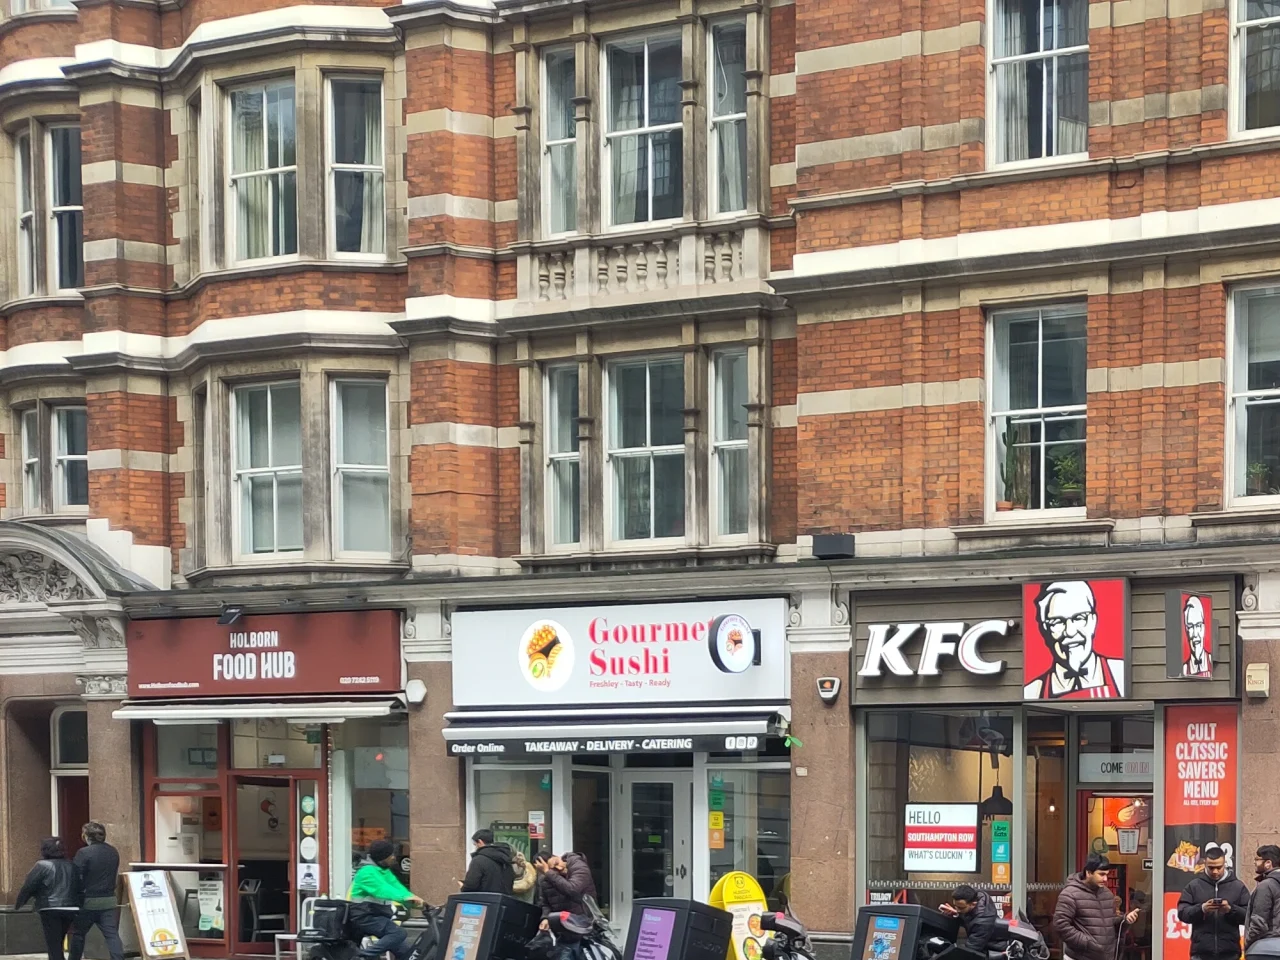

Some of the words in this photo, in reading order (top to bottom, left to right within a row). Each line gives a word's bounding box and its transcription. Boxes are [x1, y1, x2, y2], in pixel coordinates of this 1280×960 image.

[230, 630, 278, 648] HOLBORN
[857, 619, 1009, 676] KFC
[213, 652, 257, 680] FOOD
[260, 651, 295, 679] HUB
[588, 647, 671, 676] Sushi
[589, 680, 619, 689] Freshley
[624, 680, 643, 689] Tasty
[648, 679, 671, 688] Ready
[1187, 723, 1217, 740] CULT
[451, 743, 476, 753] Order
[477, 743, 505, 752] Online
[524, 741, 578, 751] TAKEAWAY
[586, 740, 635, 750] DELIVERY
[641, 738, 692, 749] CATERING
[1175, 742, 1228, 760] CLASSIC
[1100, 762, 1123, 774] COME
[1125, 762, 1138, 774] ON
[1140, 762, 1150, 774] IN
[1177, 761, 1226, 779] SAVERS
[1183, 781, 1219, 798] MENU
[908, 811, 941, 824] HELLO
[907, 833, 957, 842] SOUTHAMPTON
[958, 833, 974, 842] ROW
[908, 850, 934, 859] WHAT'S
[872, 932, 897, 940] PRICES
